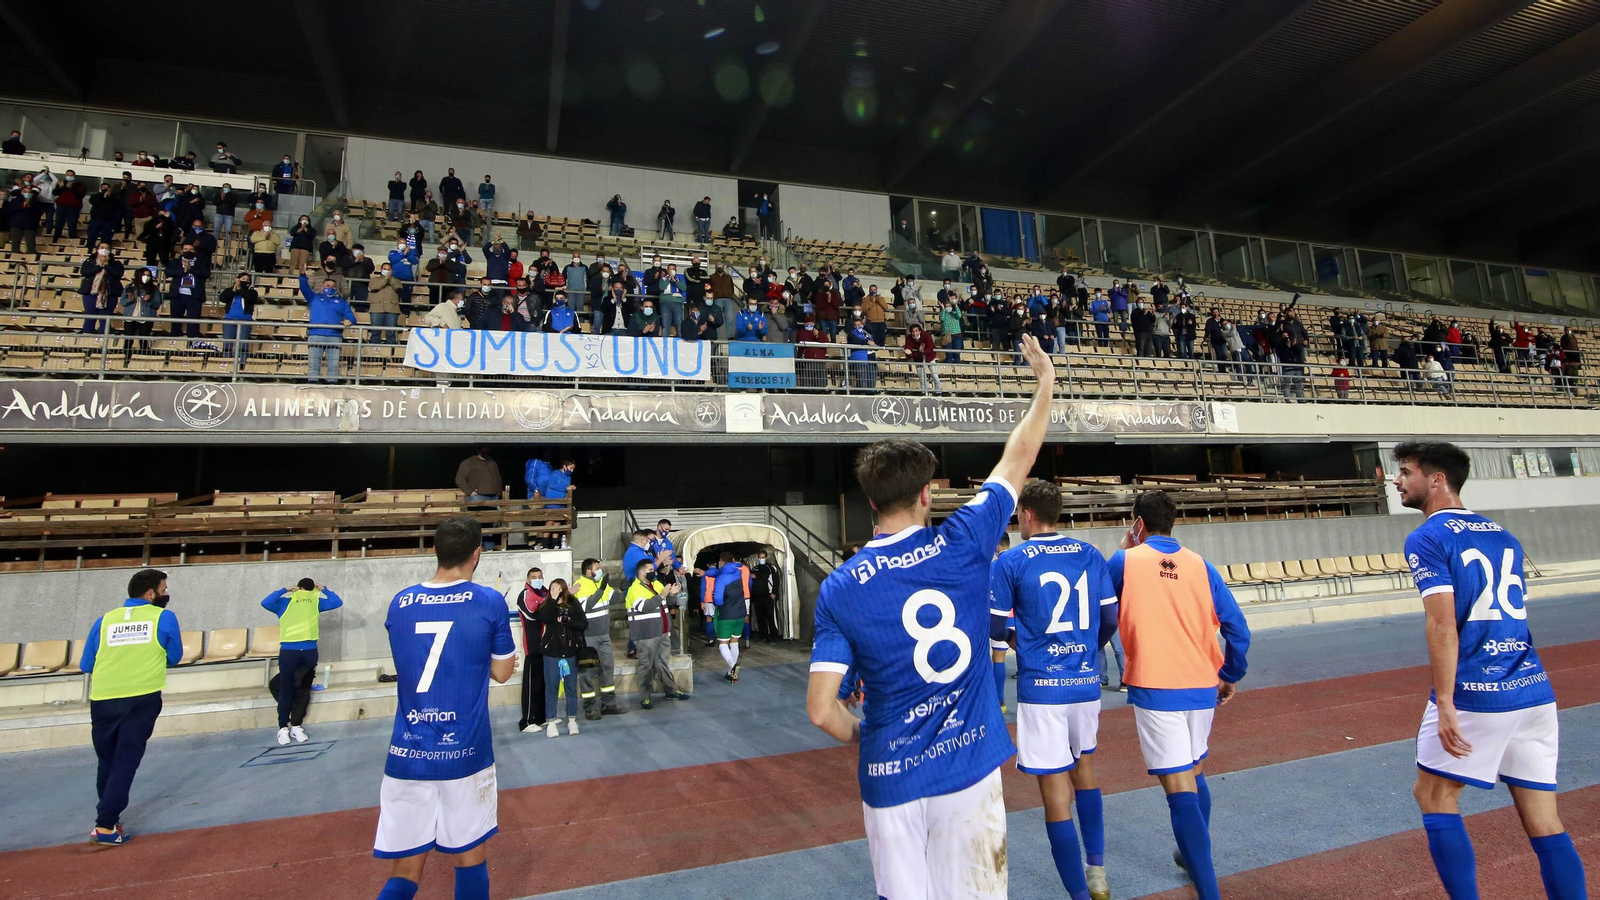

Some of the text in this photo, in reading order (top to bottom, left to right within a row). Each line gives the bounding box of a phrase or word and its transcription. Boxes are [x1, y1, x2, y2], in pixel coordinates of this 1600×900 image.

[414, 327, 704, 377] SOMOS UNO
[744, 348, 775, 357] ALMA
[734, 375, 791, 385] XERECISTA
[1, 388, 164, 422] Andalucía
[382, 400, 408, 419] DE
[417, 401, 506, 420] CALIDAD
[567, 397, 681, 426] Andalucía
[769, 401, 865, 426] Andalucía
[915, 407, 994, 424] ALIMENTOS
[1000, 409, 1016, 424] DE
[1114, 408, 1188, 428] Andalucía
[1460, 548, 1528, 622] 26
[1039, 569, 1090, 634] 21
[112, 623, 149, 634] JUMABA
[901, 588, 972, 685] 8
[415, 620, 455, 694] 7
[1034, 678, 1059, 687] XEREZ
[1060, 675, 1096, 687] DEPORTIVO
[1462, 682, 1500, 692] XEREZ
[1501, 672, 1547, 691] DEPORTIVO
[408, 748, 461, 761] DEPORTIVO
[461, 747, 476, 758] F.C.
[867, 760, 902, 777] XEREZ
